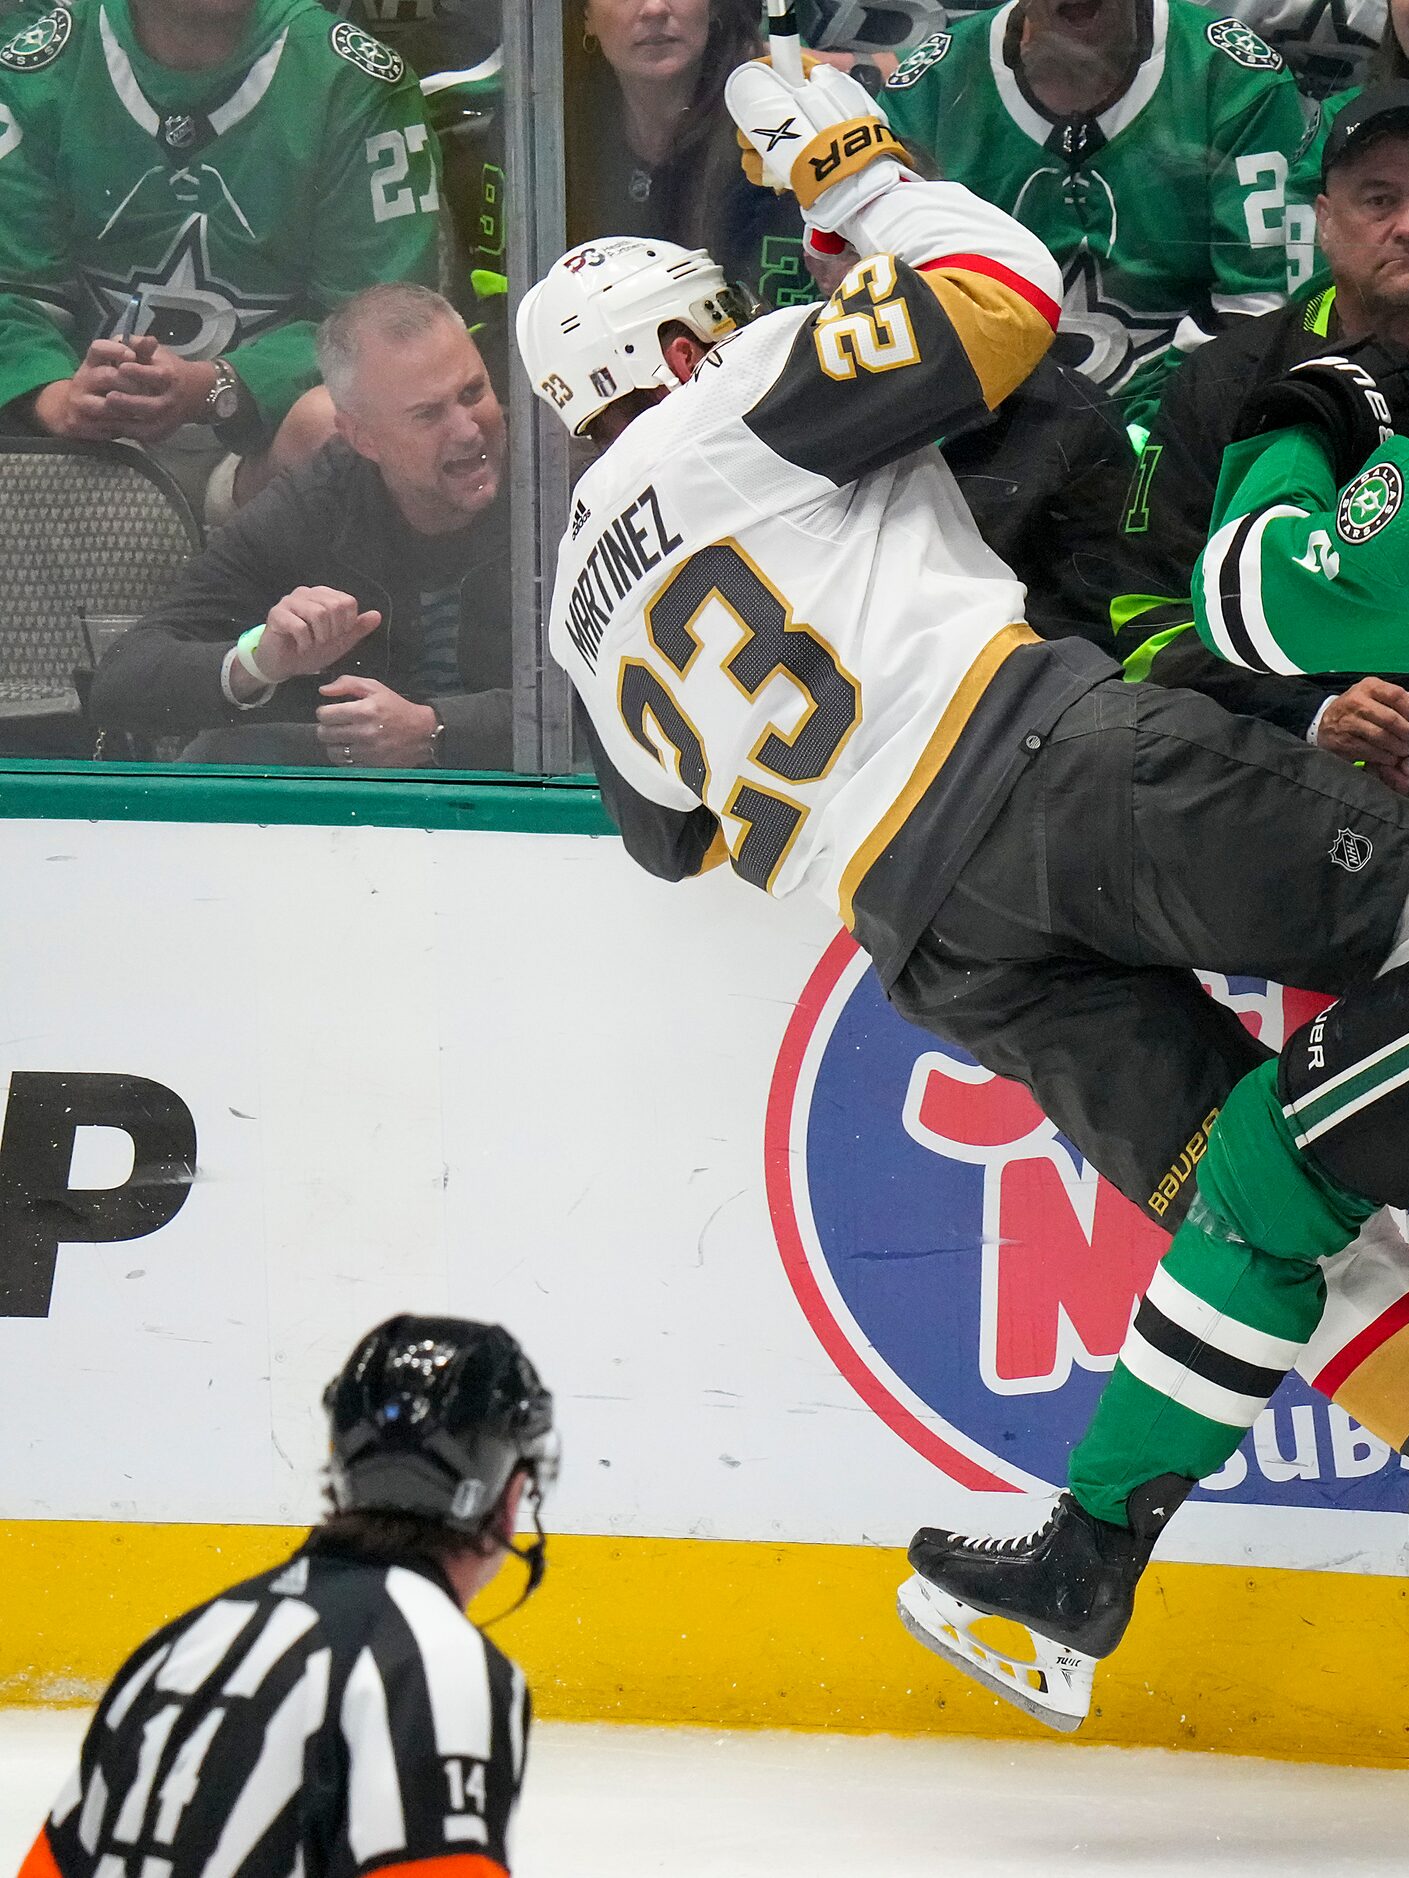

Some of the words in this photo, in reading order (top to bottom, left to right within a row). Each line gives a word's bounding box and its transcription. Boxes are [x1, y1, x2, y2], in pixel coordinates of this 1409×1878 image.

[813, 252, 922, 382] 23
[541, 373, 574, 410] 23
[565, 484, 684, 677] MARTINEZ
[444, 1759, 488, 1813] 14
